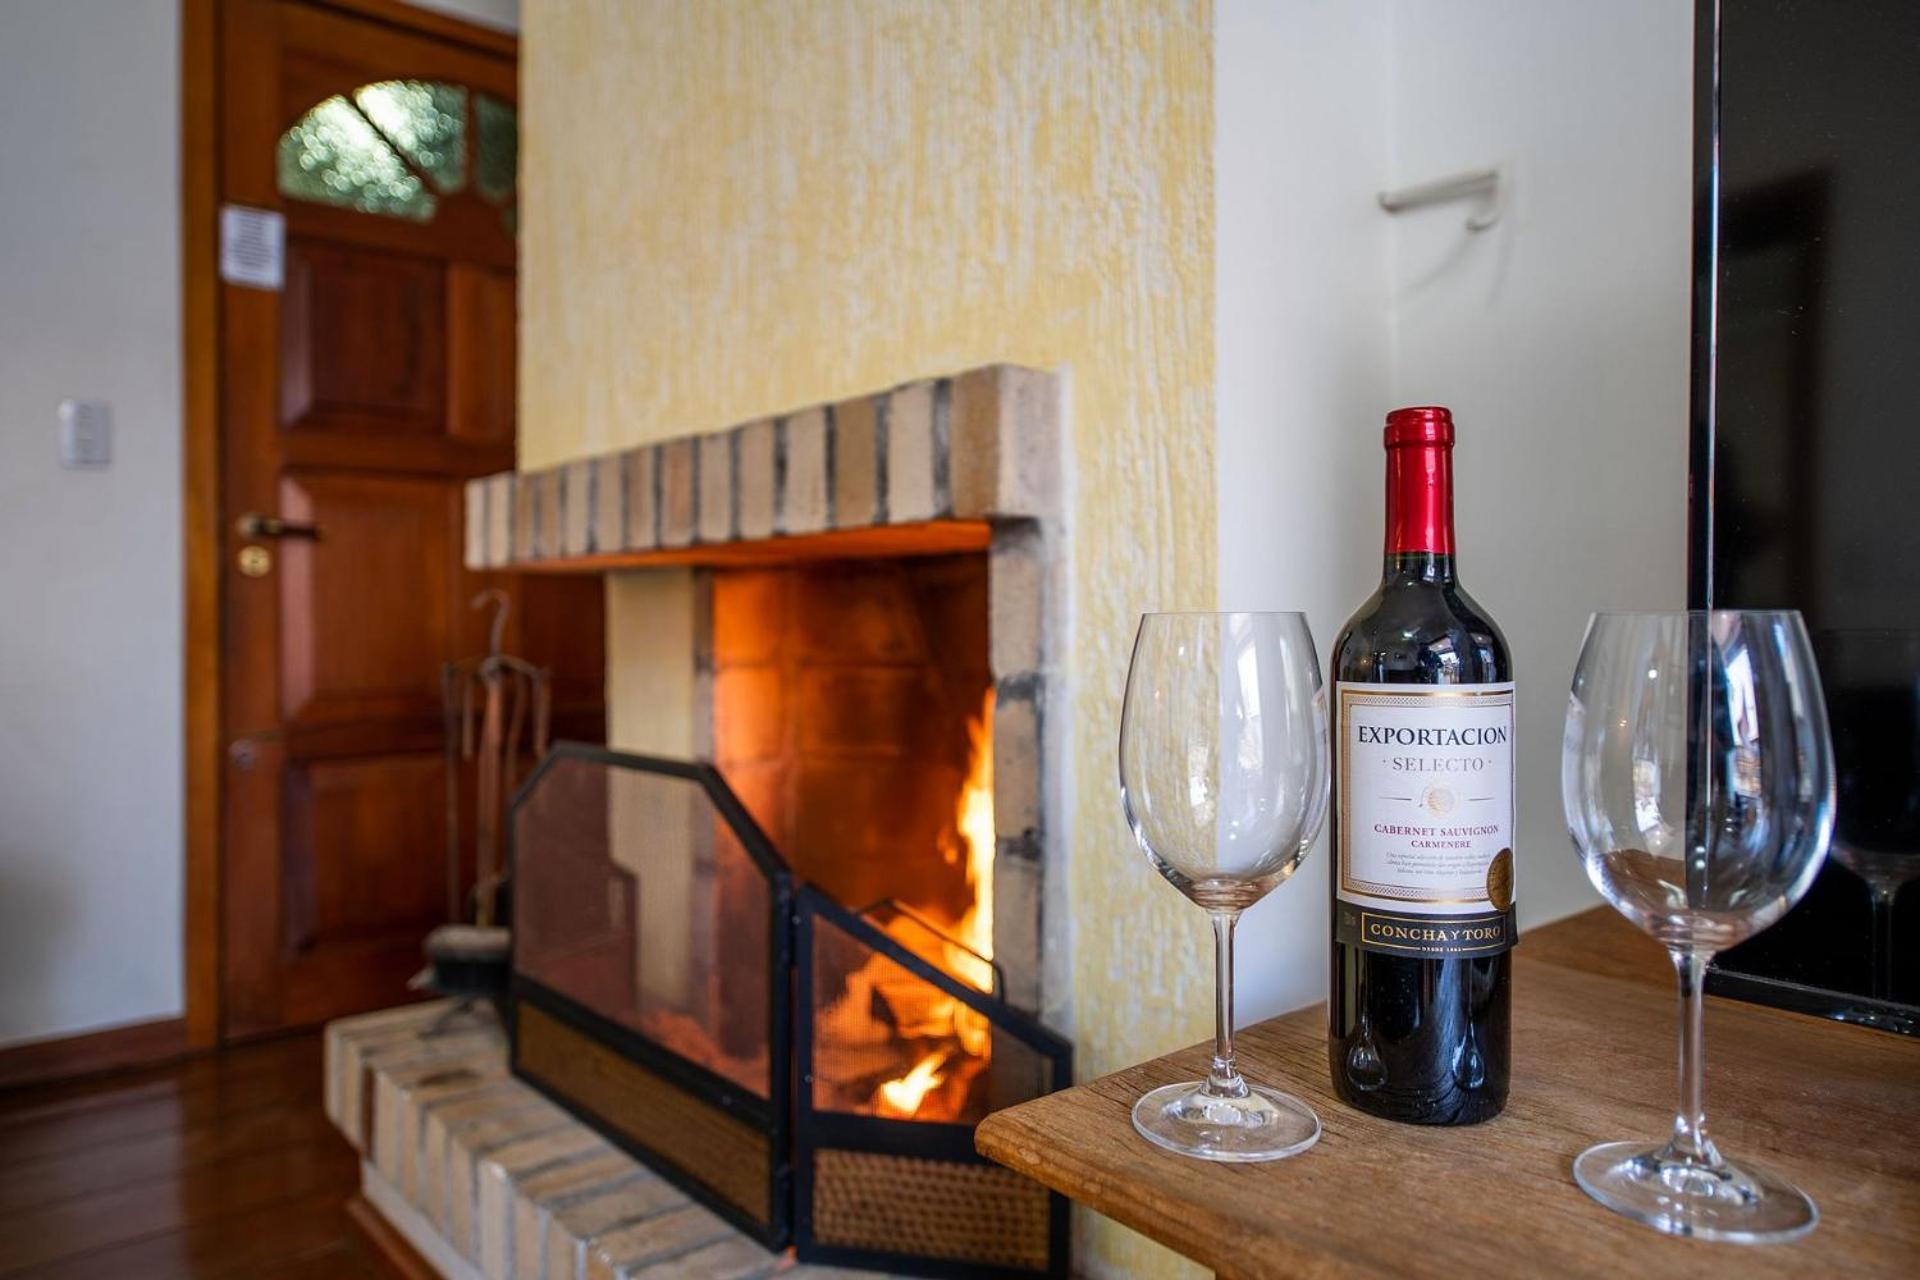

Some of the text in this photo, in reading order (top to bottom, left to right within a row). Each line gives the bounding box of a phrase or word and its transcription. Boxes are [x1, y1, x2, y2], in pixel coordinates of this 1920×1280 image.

[1358, 725, 1507, 746] EXPORTACION
[1392, 756, 1484, 772] SELECTO
[1374, 823, 1499, 837] CABERNET SAUVIGNON
[1411, 840, 1471, 849] CARMENERE
[1370, 923, 1448, 941] CONCHA
[1462, 926, 1501, 941] TORO
